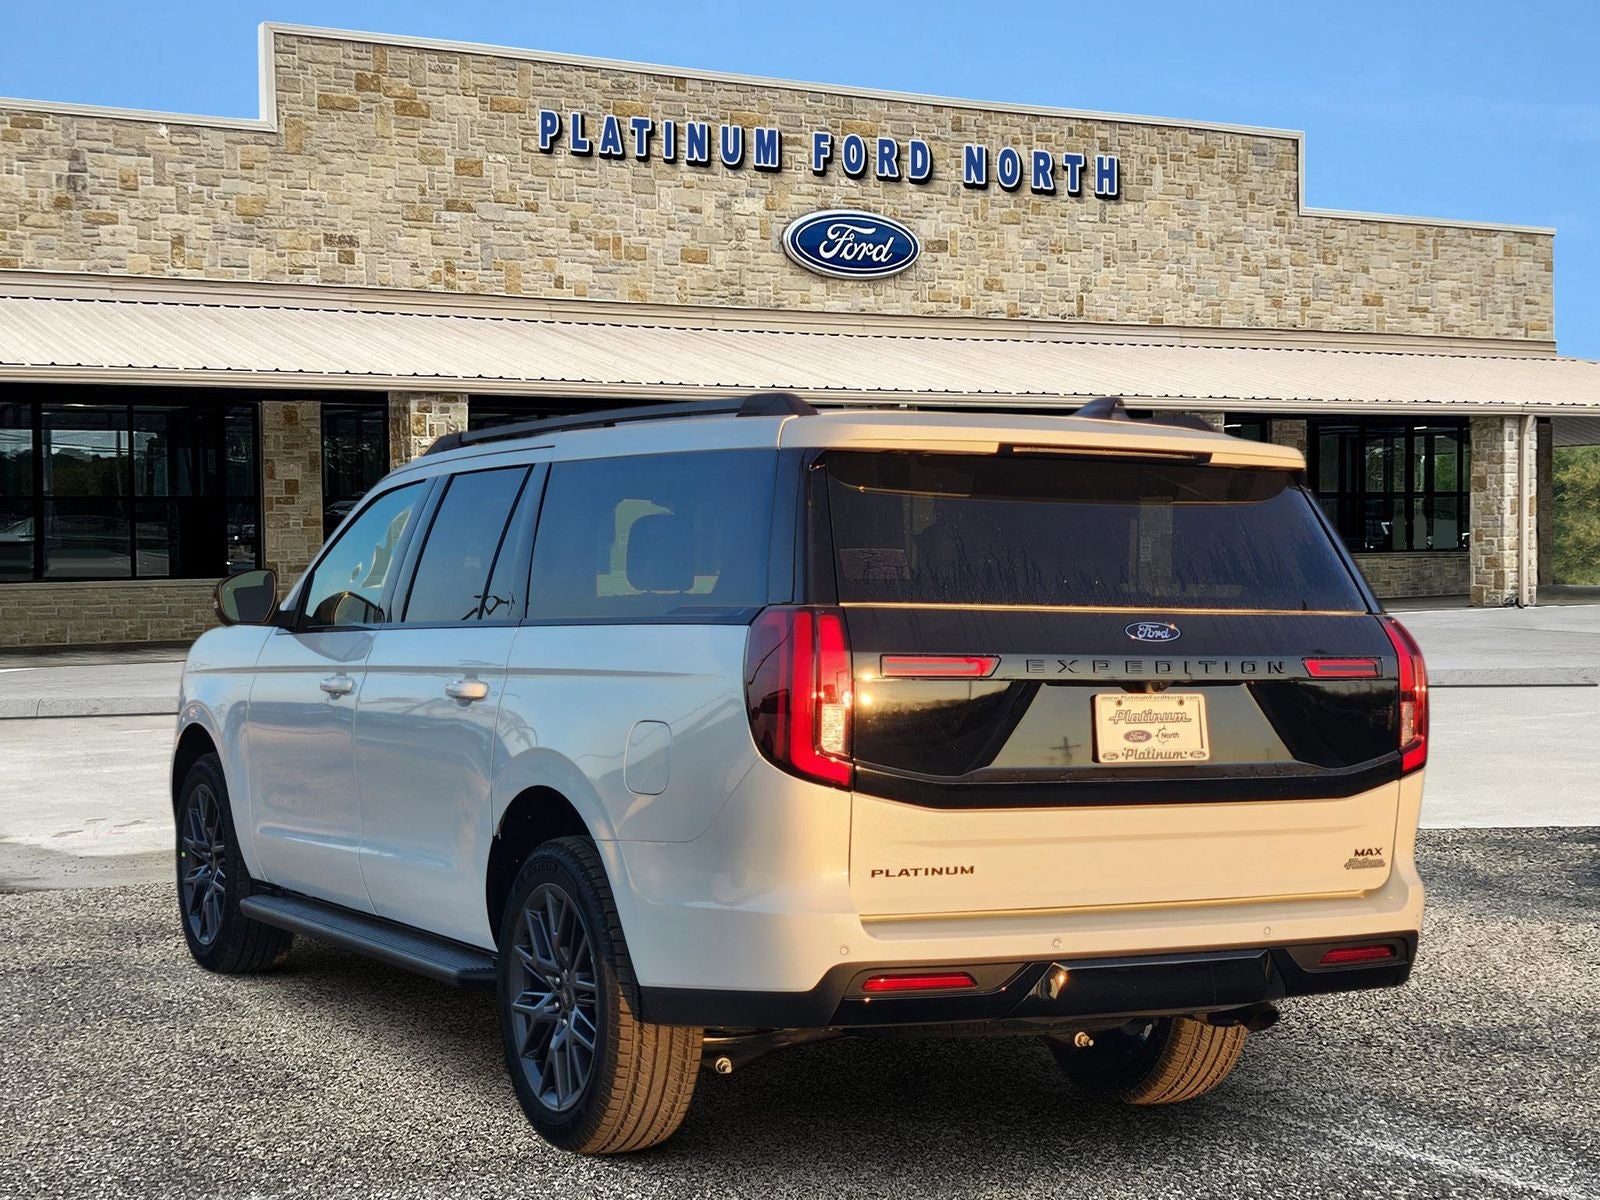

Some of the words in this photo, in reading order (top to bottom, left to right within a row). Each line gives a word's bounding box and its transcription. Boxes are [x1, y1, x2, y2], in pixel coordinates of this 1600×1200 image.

[538, 108, 782, 171] PLATINUM
[813, 132, 932, 184] FORD
[963, 144, 1120, 200] NORTH
[818, 223, 893, 265] Ford
[1136, 624, 1171, 640] Ford
[1026, 659, 1286, 675] EXPEDITION
[1108, 708, 1192, 725] Platinum
[1161, 732, 1180, 740] North
[1125, 748, 1187, 761] Platinum
[1354, 847, 1383, 857] MAX
[871, 865, 975, 878] PLATINUM
